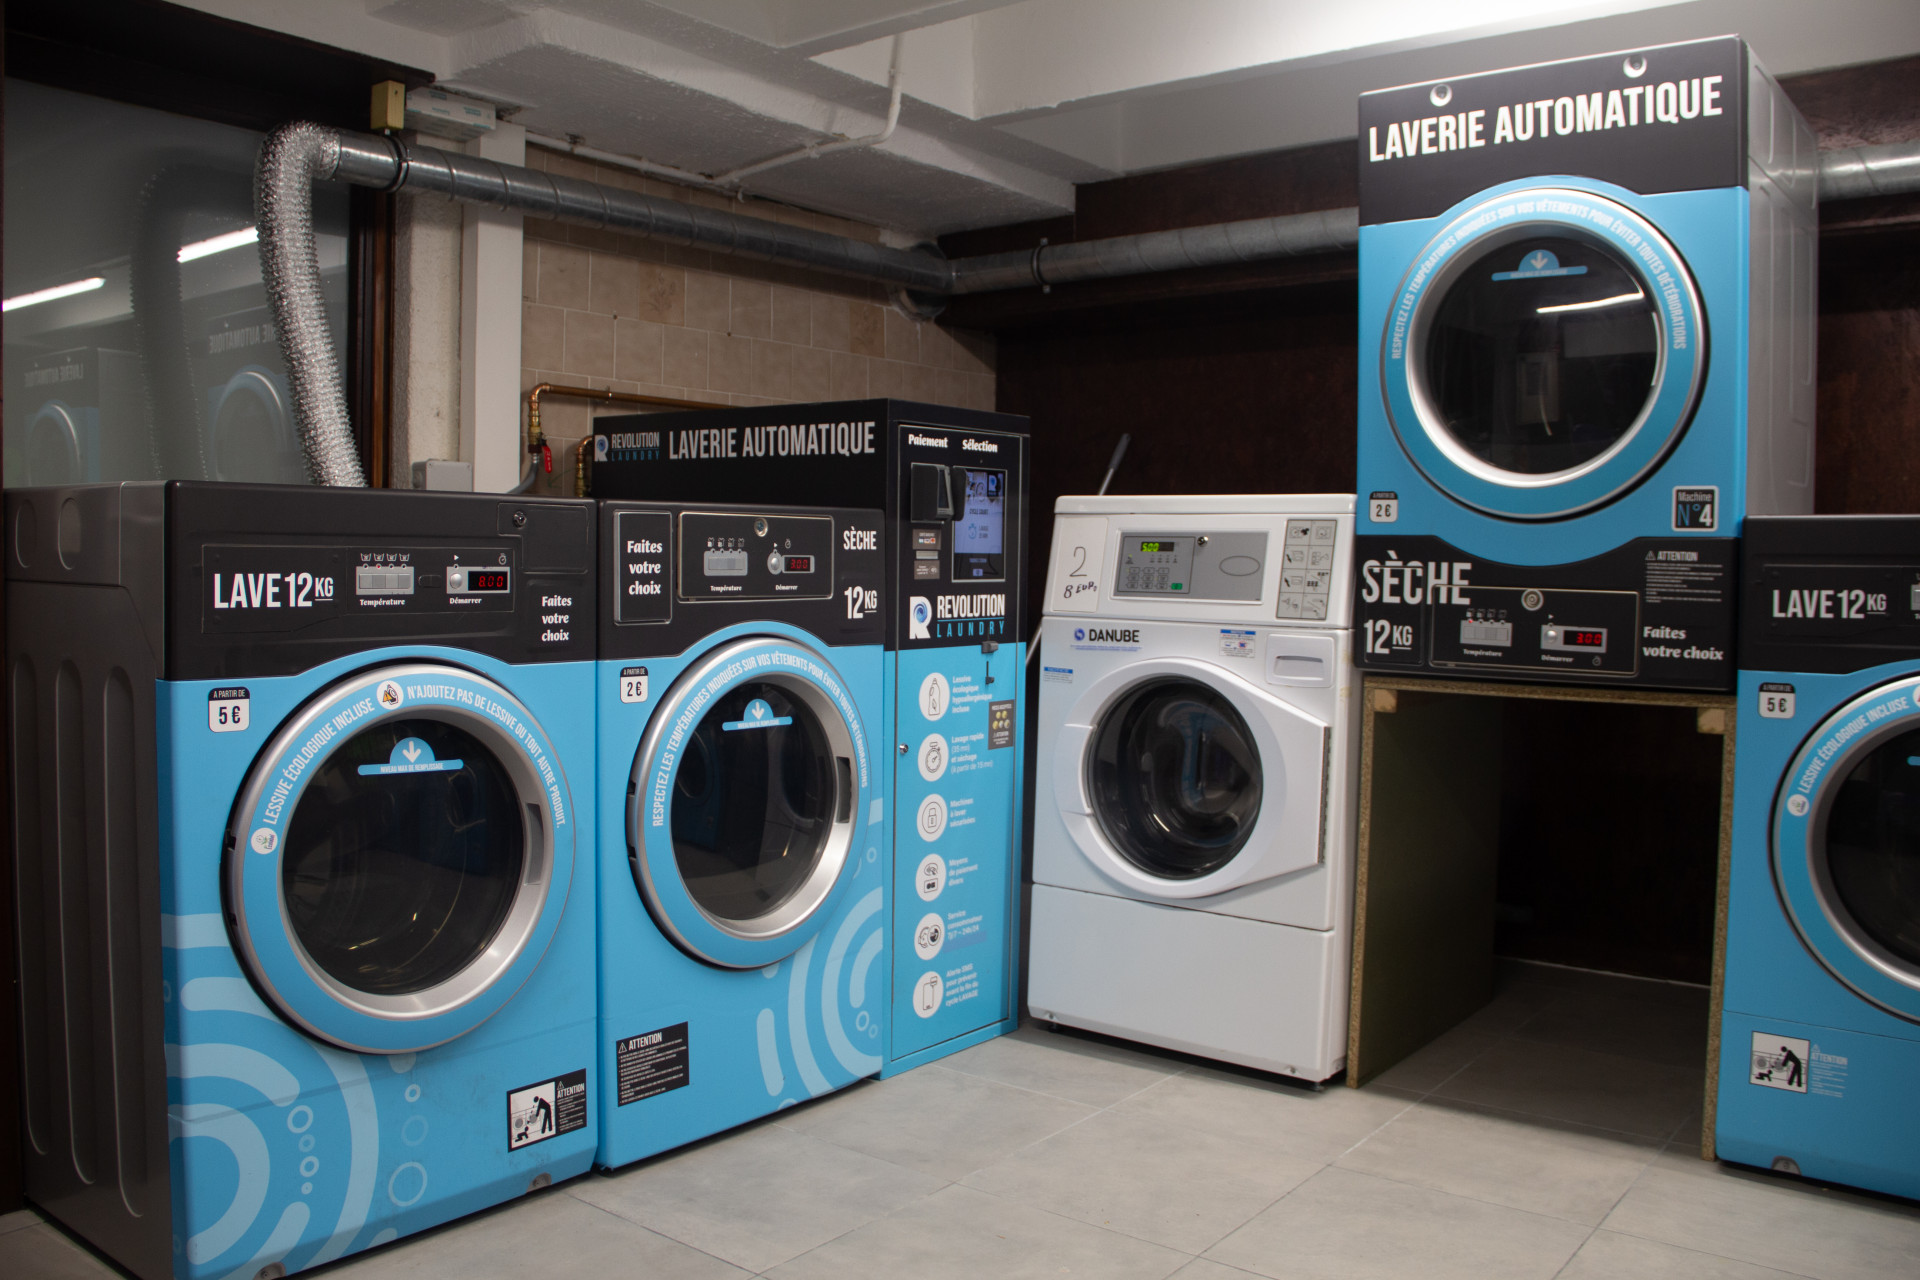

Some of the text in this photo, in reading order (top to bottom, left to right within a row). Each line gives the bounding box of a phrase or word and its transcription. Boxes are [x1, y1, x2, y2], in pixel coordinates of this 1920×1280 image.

[1369, 75, 1723, 162] LAVERIE AUTOMATIQUE
[1497, 204, 1516, 219] SUR
[1517, 201, 1535, 214] VOS
[1588, 207, 1615, 228] POUR
[1610, 215, 1641, 247] ÉVITER
[1407, 235, 1457, 293] TEMPÉRATURES
[1636, 240, 1666, 275] TOUTES
[1401, 292, 1415, 311] LES
[1656, 271, 1687, 350] DÉTÉRIORATIONS
[1392, 309, 1409, 359] RESPECTEZ
[611, 432, 660, 449] REVOLUTION
[669, 421, 876, 460] LAVERIE AUTOMATIQUE
[908, 433, 948, 448] Paiement
[962, 438, 998, 453] Sélection
[611, 449, 660, 462] LAUNDRY
[1678, 491, 1712, 502] Machine
[1376, 504, 1391, 517] 2 €
[627, 539, 663, 554] Faites
[843, 526, 877, 551] SÈCHE
[1069, 546, 1087, 577] 2
[1657, 551, 1698, 561] ATTENTION
[628, 561, 661, 575] votre
[1361, 550, 1472, 606] SÈCHE
[214, 573, 281, 609] LAVE
[628, 581, 662, 596] choix
[710, 584, 742, 592] Température
[1063, 584, 1073, 599] 8
[360, 598, 405, 608] Température
[449, 597, 482, 605] Démarrer
[541, 595, 572, 607] Faites
[937, 594, 1005, 619] REVOLUTION
[1772, 589, 1834, 618] LAVE
[541, 612, 569, 624] votre
[541, 629, 569, 642] choix
[936, 620, 1005, 638] LAUNDRY
[1089, 628, 1140, 643] DANUBE
[1643, 625, 1686, 640] Faites
[756, 653, 771, 666] VOS
[771, 650, 808, 670] VÊTEMENTS
[1642, 645, 1723, 661] votre choix
[742, 655, 757, 671] SUR
[808, 661, 824, 681] POUR
[706, 661, 743, 694] INDIQUÉES
[821, 671, 841, 700] ÉVITER
[213, 689, 245, 699] A PARTIR DE
[627, 681, 642, 697] 2 €
[838, 693, 855, 722] TOUTES
[1767, 698, 1787, 713] 5 €
[219, 705, 241, 725] 5 €
[667, 688, 711, 753] TEMPÉRATURES
[1797, 696, 1910, 794] LESSIVE ÉCOLOGIQUE INCLUSE
[262, 697, 375, 826] LESSIVE ÉCOLOGIQUE INCLUSE
[407, 685, 566, 829] N'AJOUTEZ PAS DE LESSIVE OU TOUT AUTRE PRODUIT.
[660, 751, 675, 772] LES
[652, 771, 669, 827] RESPECTEZ
[628, 1031, 663, 1051] ATTENTION
[1811, 1052, 1848, 1066] ATTENTION
[557, 1083, 585, 1099] ATTENTION
